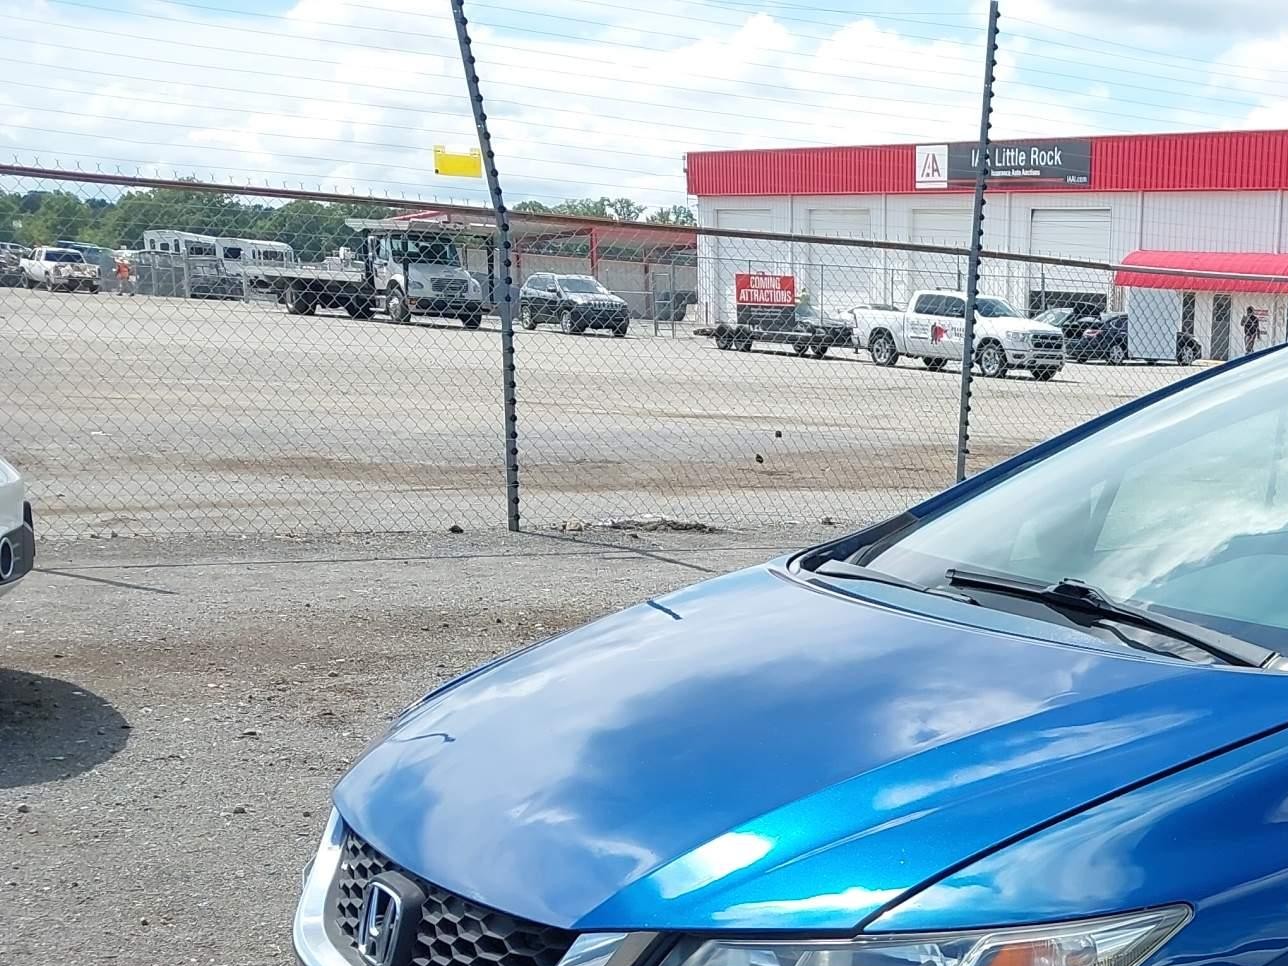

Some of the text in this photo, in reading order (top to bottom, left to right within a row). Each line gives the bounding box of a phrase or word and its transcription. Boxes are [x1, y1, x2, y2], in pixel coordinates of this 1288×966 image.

[995, 147, 1026, 167] Little
[1030, 146, 1062, 166] Rock
[750, 276, 781, 290] COMING
[739, 288, 792, 303] ATTRACTIONS
